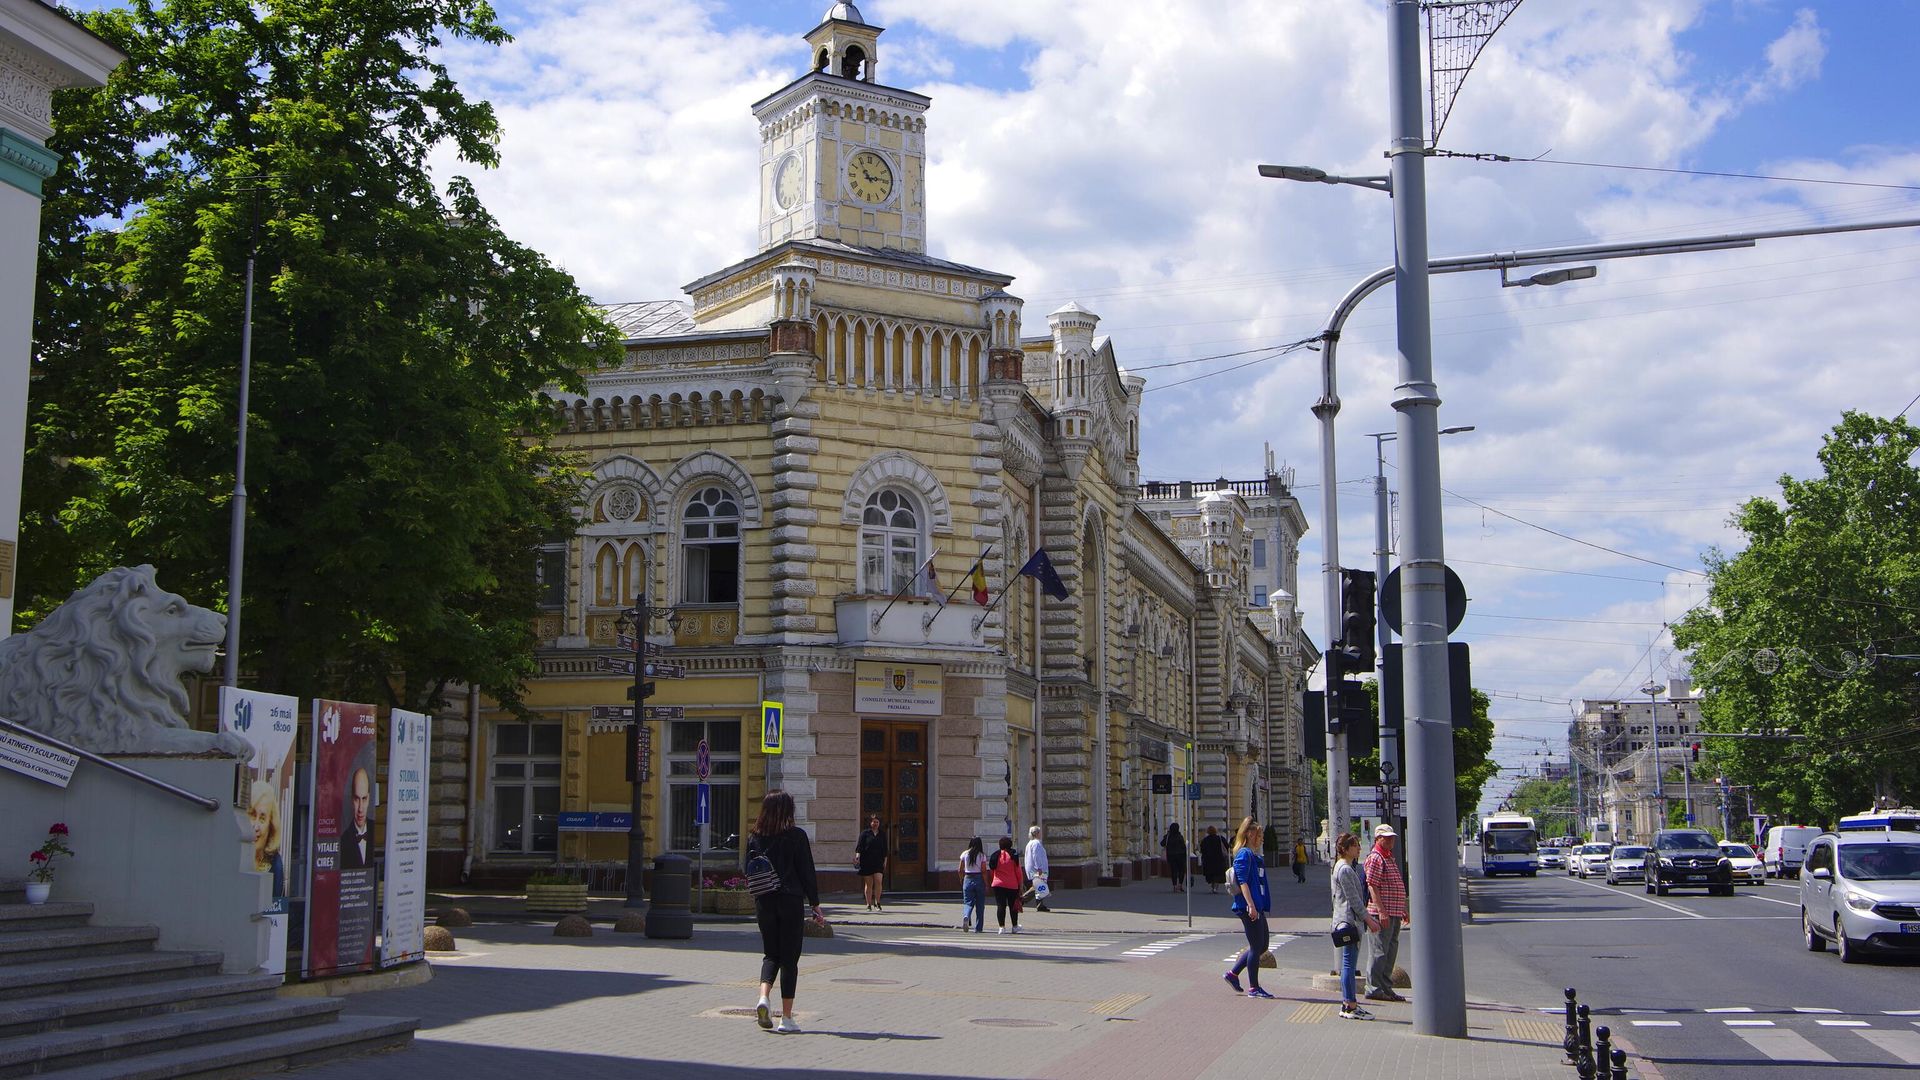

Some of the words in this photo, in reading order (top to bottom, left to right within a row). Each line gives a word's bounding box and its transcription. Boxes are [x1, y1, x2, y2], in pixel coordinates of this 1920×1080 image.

[270, 707, 279, 717] 26
[279, 709, 292, 719] mai
[273, 721, 291, 733] 18:00
[317, 842, 339, 853] VITALIE
